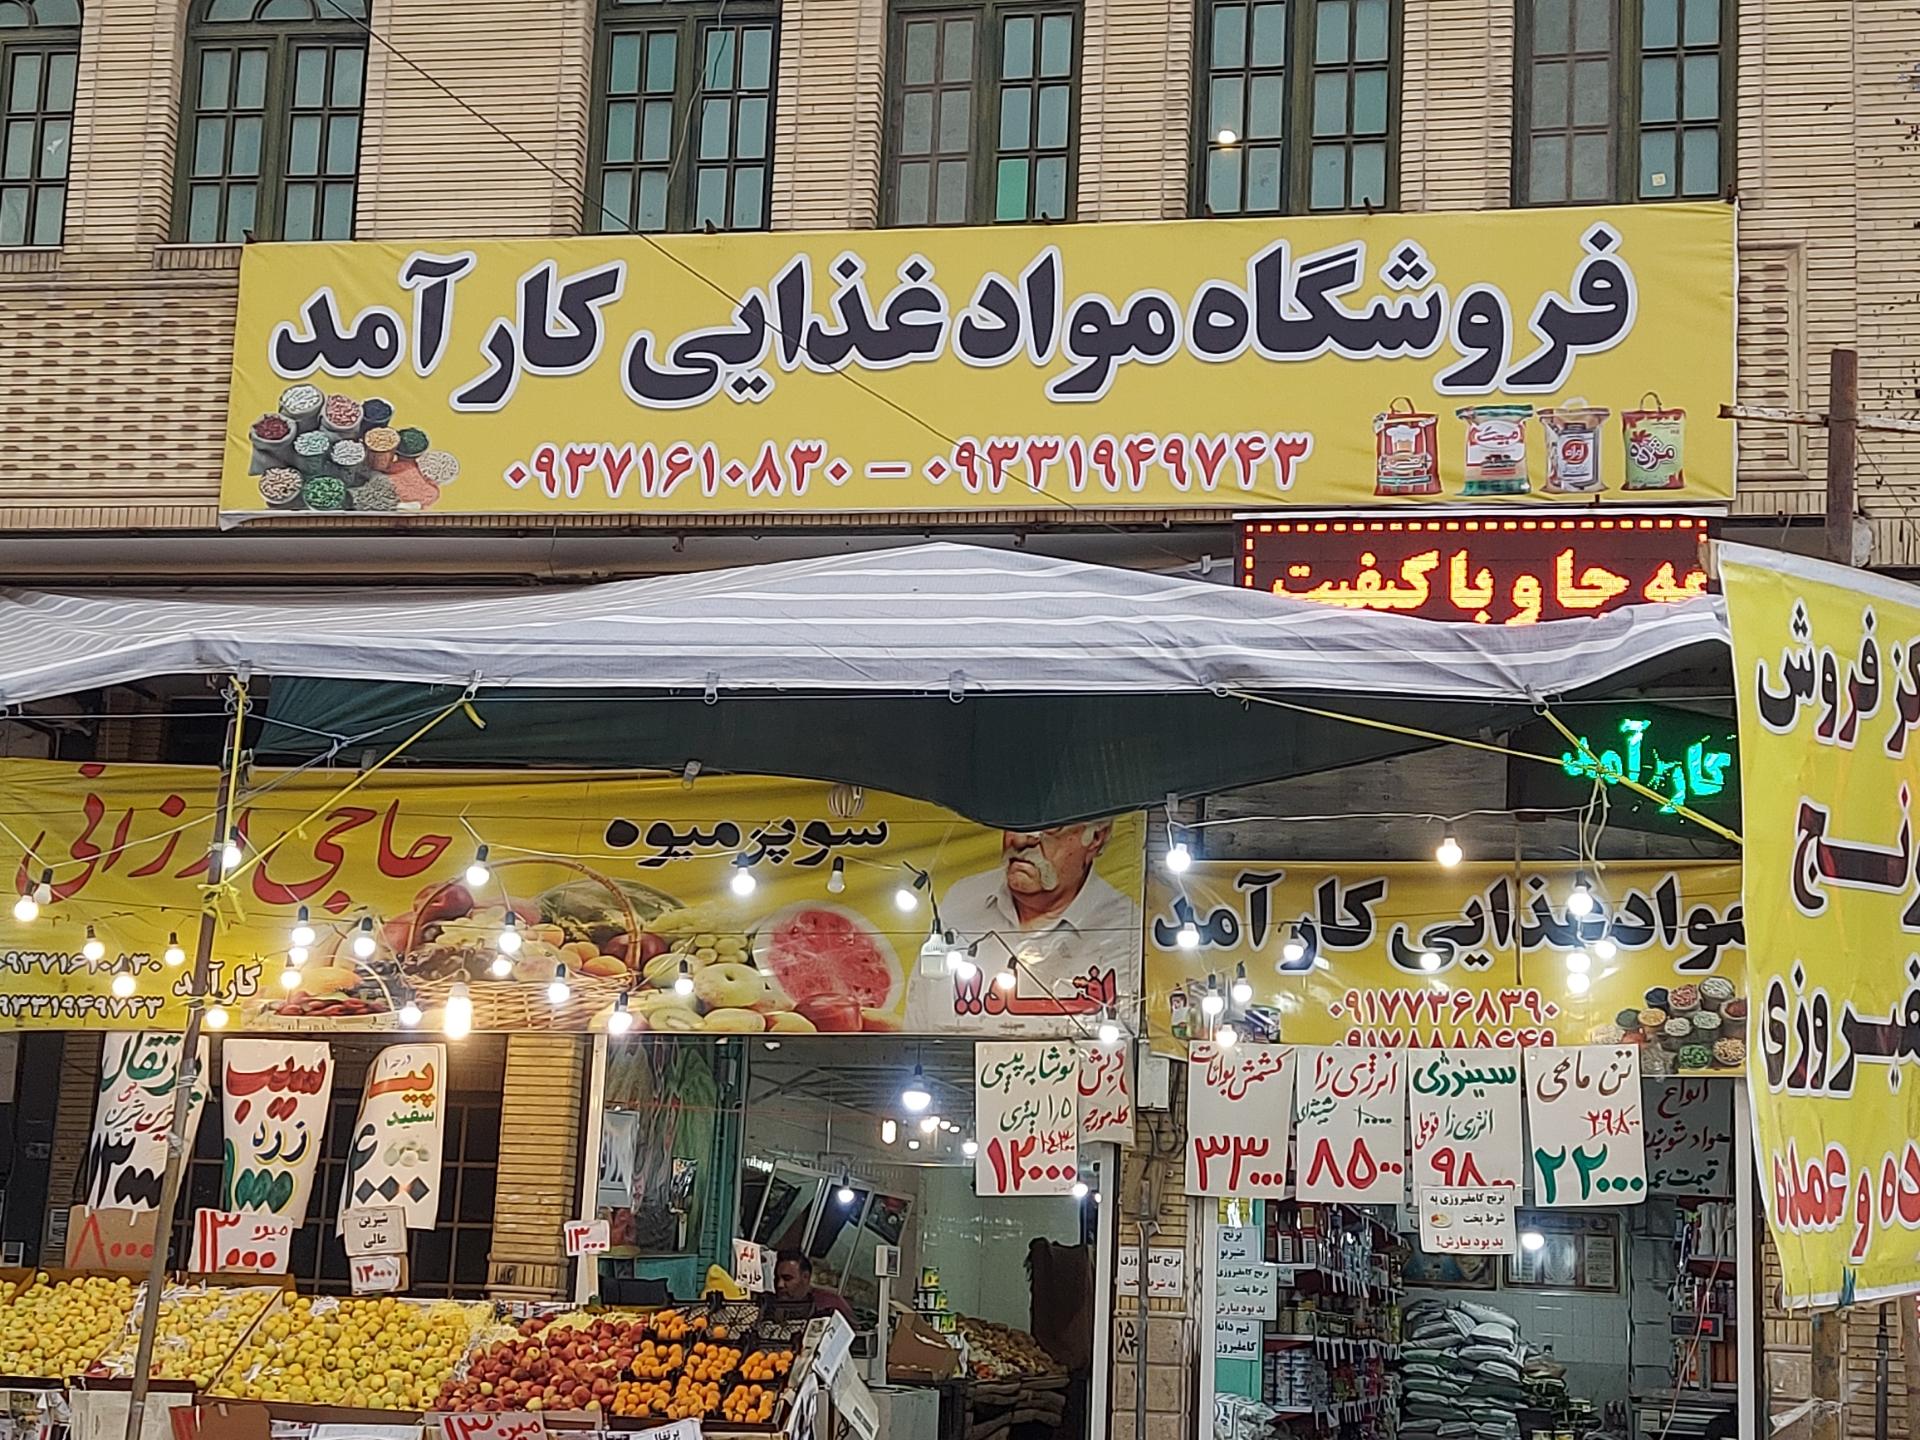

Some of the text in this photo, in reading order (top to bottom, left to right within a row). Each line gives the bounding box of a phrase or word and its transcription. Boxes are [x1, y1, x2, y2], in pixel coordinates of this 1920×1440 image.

[624, 256, 948, 408] غذایی
[955, 245, 1179, 400] مواد
[1194, 222, 1637, 394] فروشگاه
[504, 442, 850, 497] ۰۹۳۷۱۶۱۰۸۳۰
[927, 431, 1312, 492] ۰۹۳۳۱۹۴۹۷۴۳
[1449, 550, 1492, 624] با
[1757, 598, 1881, 750] فروش
[15, 764, 452, 915] حاجی ارزانی
[1329, 988, 1559, 1026] ۰۹۱۷۷۳۶۸۳۹۰
[226, 1055, 327, 1125] سیب
[1331, 1051, 1399, 1100] انرژی
[1536, 1050, 1633, 1103] تن ماهی
[252, 1120, 312, 1165] زرد
[386, 1105, 435, 1129] سفید
[1194, 1135, 1283, 1192] ۳۳۰۰۰
[1306, 1137, 1403, 1190] ۸۵۰۰
[1534, 1143, 1644, 1205] ۲۲۰۰۰
[359, 1213, 388, 1228] شیرین
[1463, 1213, 1506, 1226] شرط پخت
[1486, 1194, 1505, 1206] برنج
[364, 1233, 387, 1249] عالی
[1223, 1231, 1242, 1241] برنج
[1234, 1286, 1268, 1296] شرط پخت
[1236, 1322, 1250, 1336] نیم
